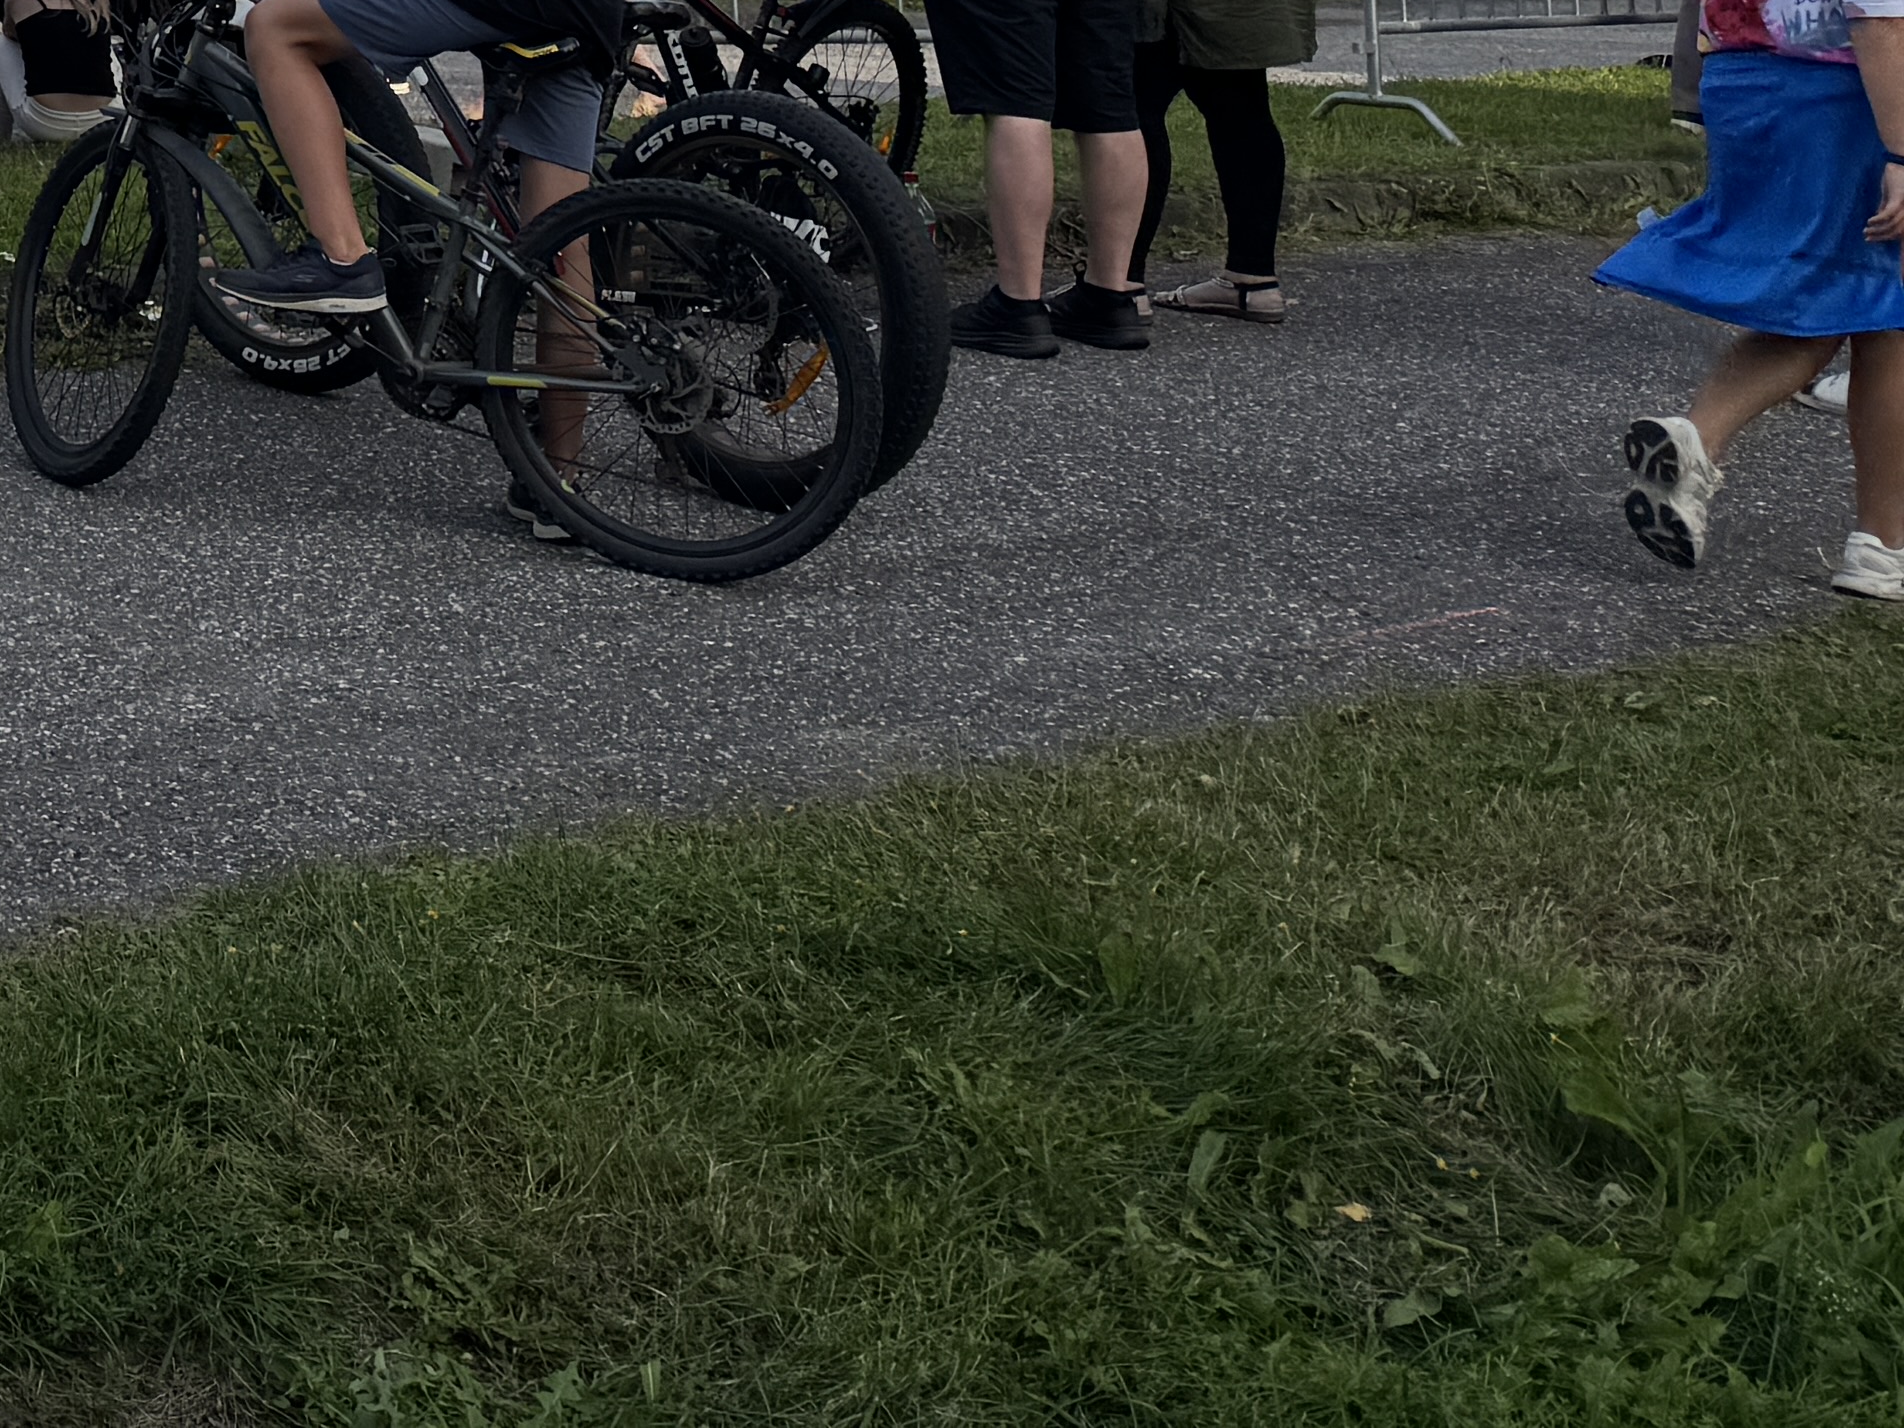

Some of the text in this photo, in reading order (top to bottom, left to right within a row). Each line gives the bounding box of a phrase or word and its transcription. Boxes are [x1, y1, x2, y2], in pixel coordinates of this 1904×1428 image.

[635, 114, 839, 181] CST BFT 26x4.0
